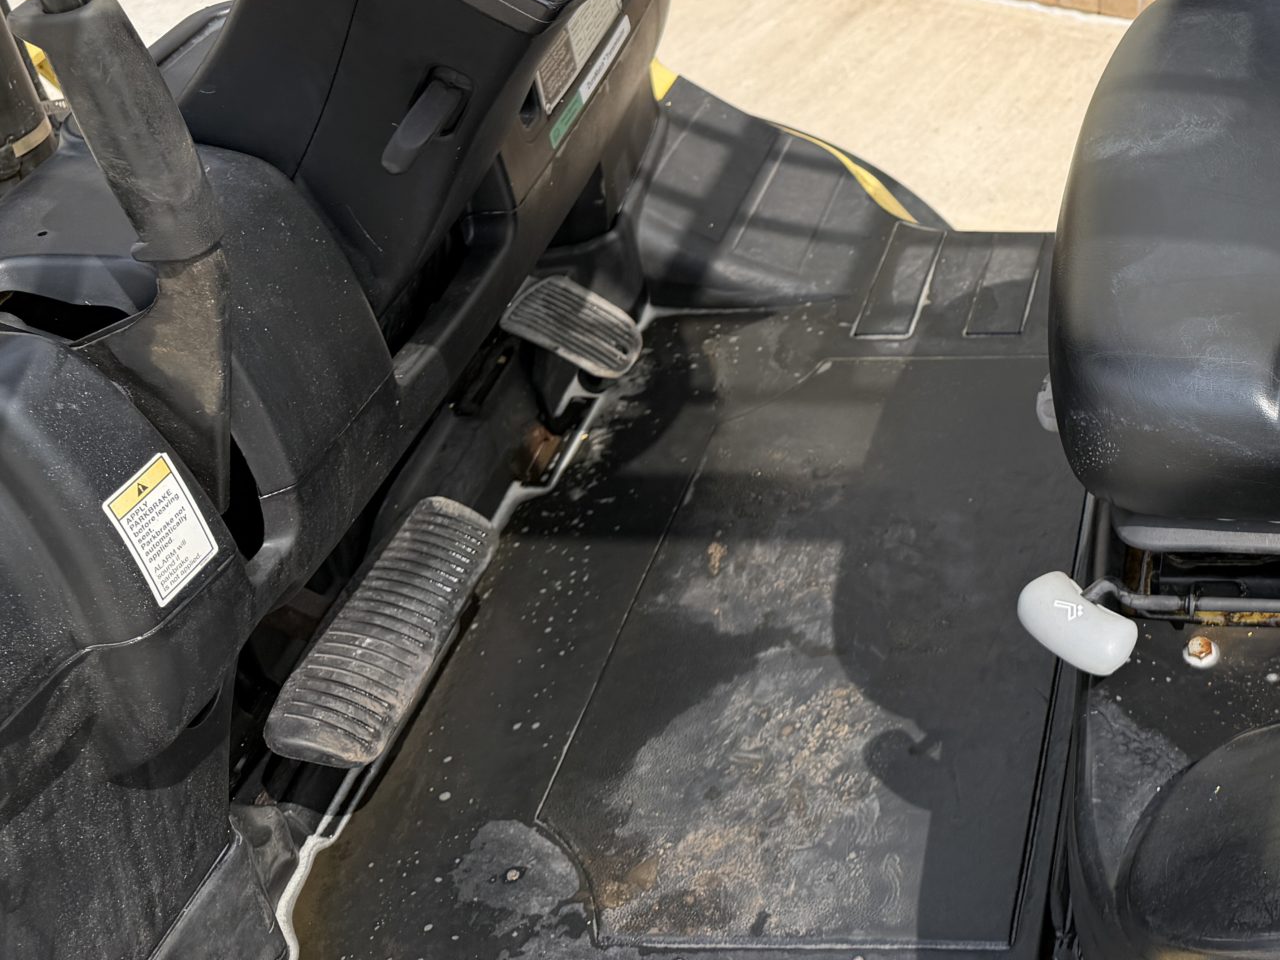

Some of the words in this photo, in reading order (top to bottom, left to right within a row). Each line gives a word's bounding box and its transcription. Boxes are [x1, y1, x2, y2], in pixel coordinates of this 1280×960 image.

[124, 500, 149, 525] APPLY
[128, 488, 173, 531] PARKBRAKE
[132, 513, 156, 538] before
[154, 491, 179, 517] leaving
[137, 526, 154, 544] seat.
[140, 516, 175, 550] Parkbrake
[173, 505, 185, 518] not
[143, 512, 188, 557] automatically
[152, 548, 176, 573] ALARM
[175, 538, 187, 551] will
[156, 559, 175, 580] sound
[174, 553, 180, 561] if
[159, 555, 189, 587] parkbrake
[163, 583, 169, 592] is
[169, 573, 179, 586] not
